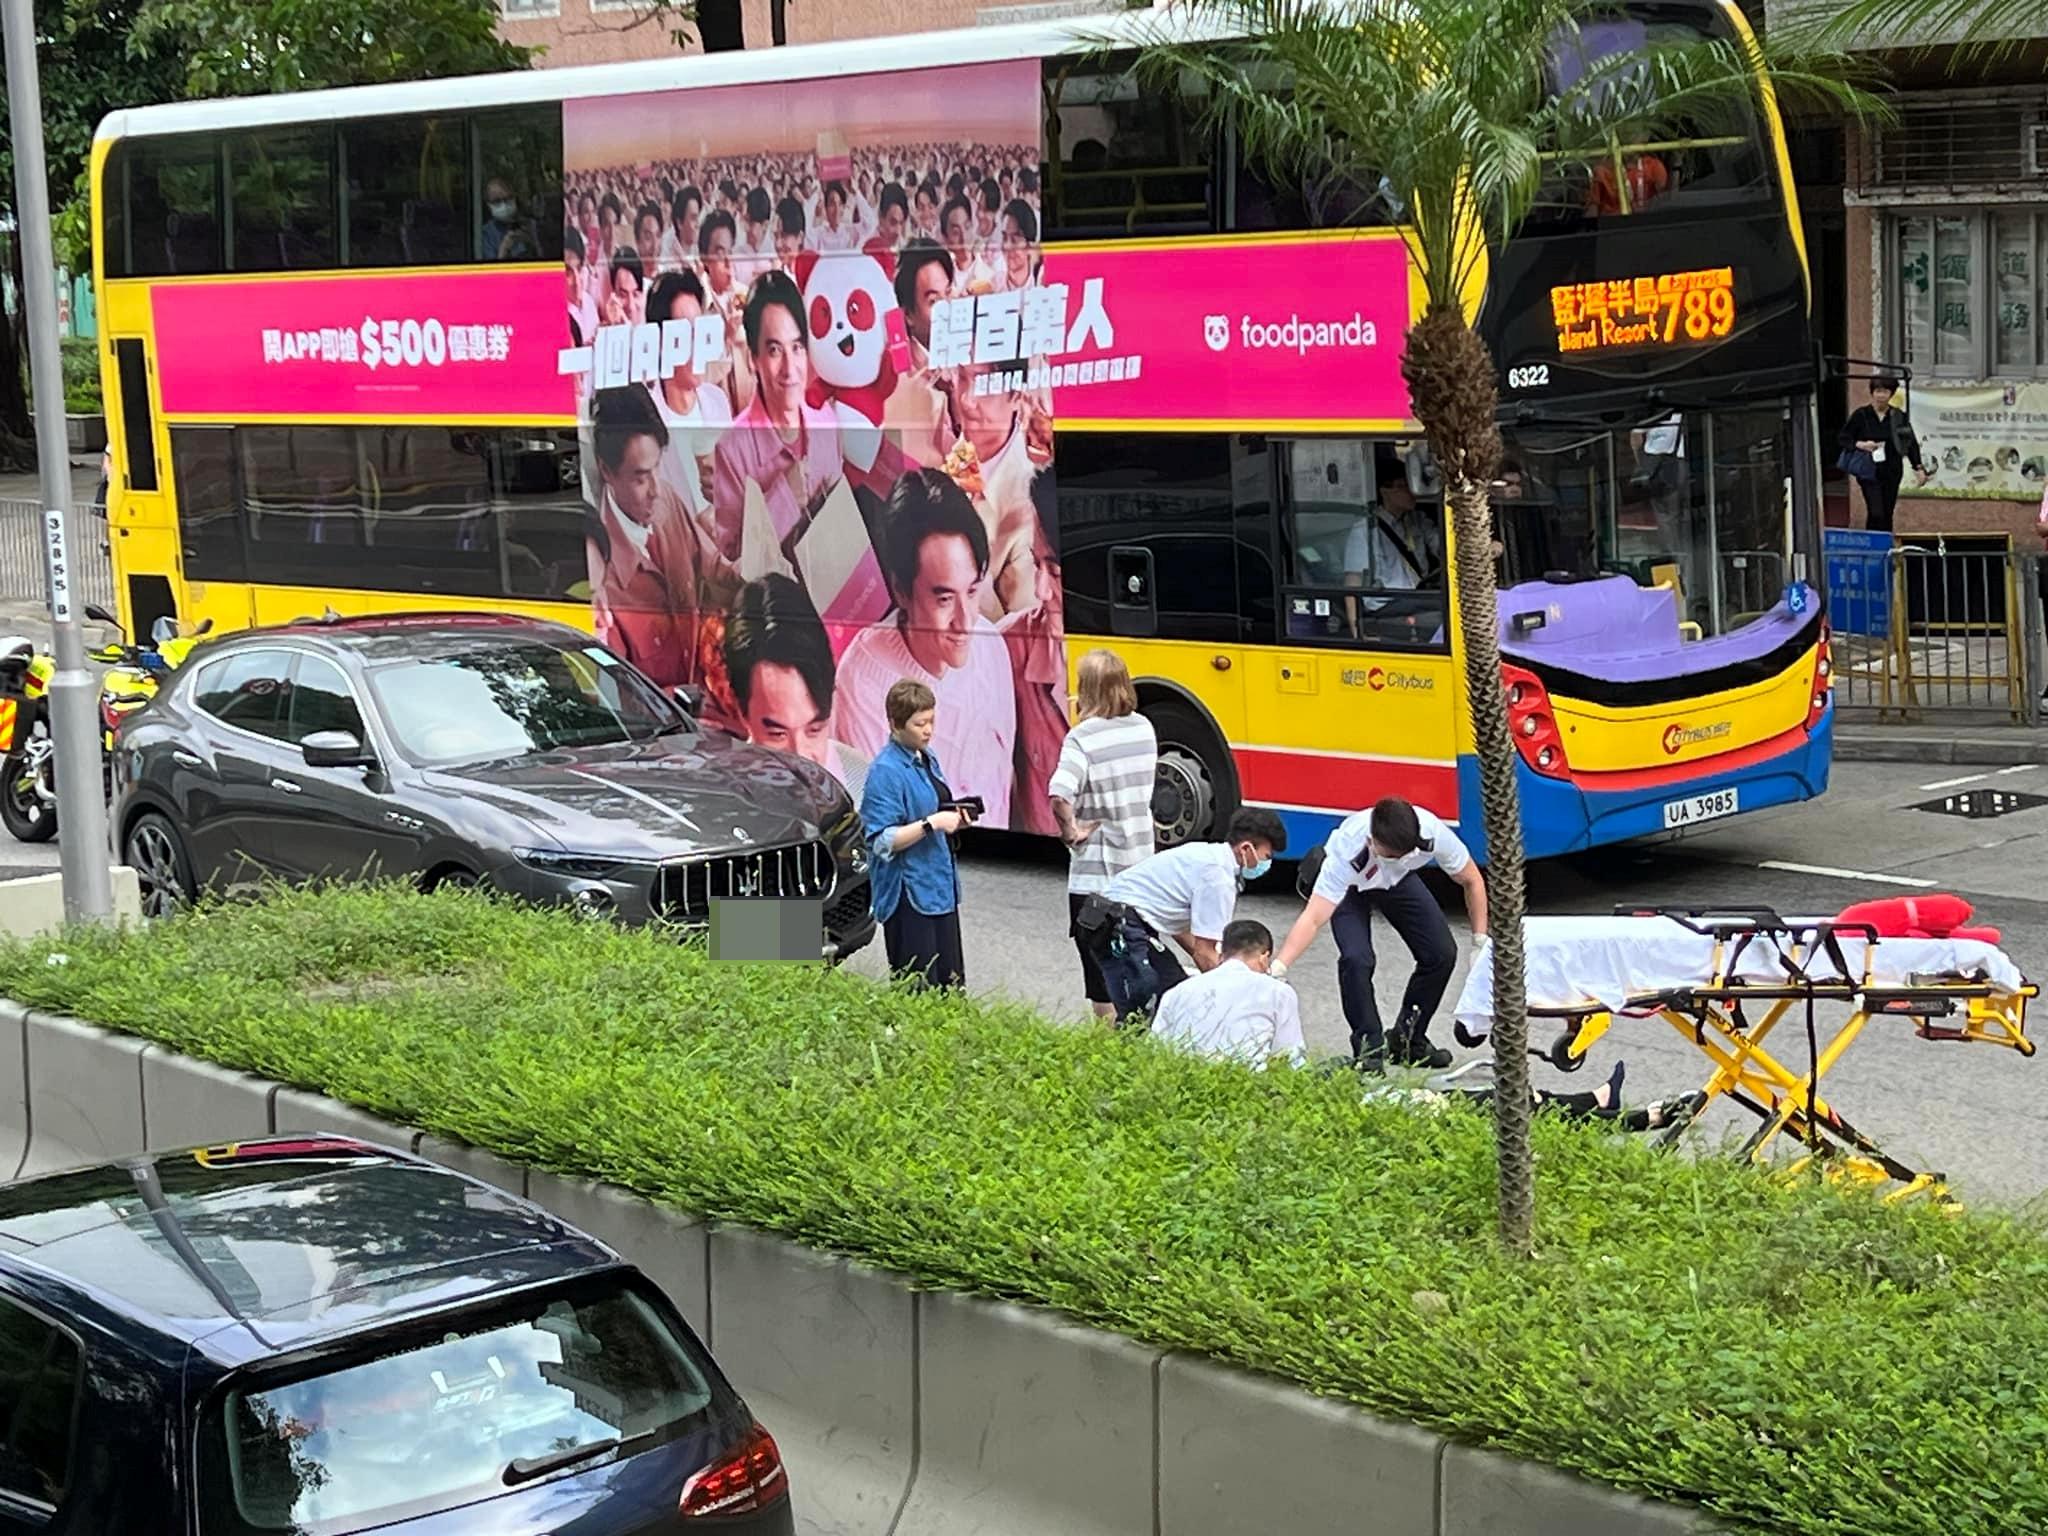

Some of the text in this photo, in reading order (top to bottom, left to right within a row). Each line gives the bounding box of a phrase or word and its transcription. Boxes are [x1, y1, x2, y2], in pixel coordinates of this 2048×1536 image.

[1551, 276, 1659, 327] 藍灣半島
[1659, 287, 1735, 343] 789
[1240, 312, 1377, 356] foodpanda
[1601, 314, 1659, 347] Resort
[558, 314, 725, 389] 一個APP
[1508, 364, 1549, 389] 6322
[1387, 672, 1434, 690] Citybus
[1669, 792, 1734, 824] UA 3985
